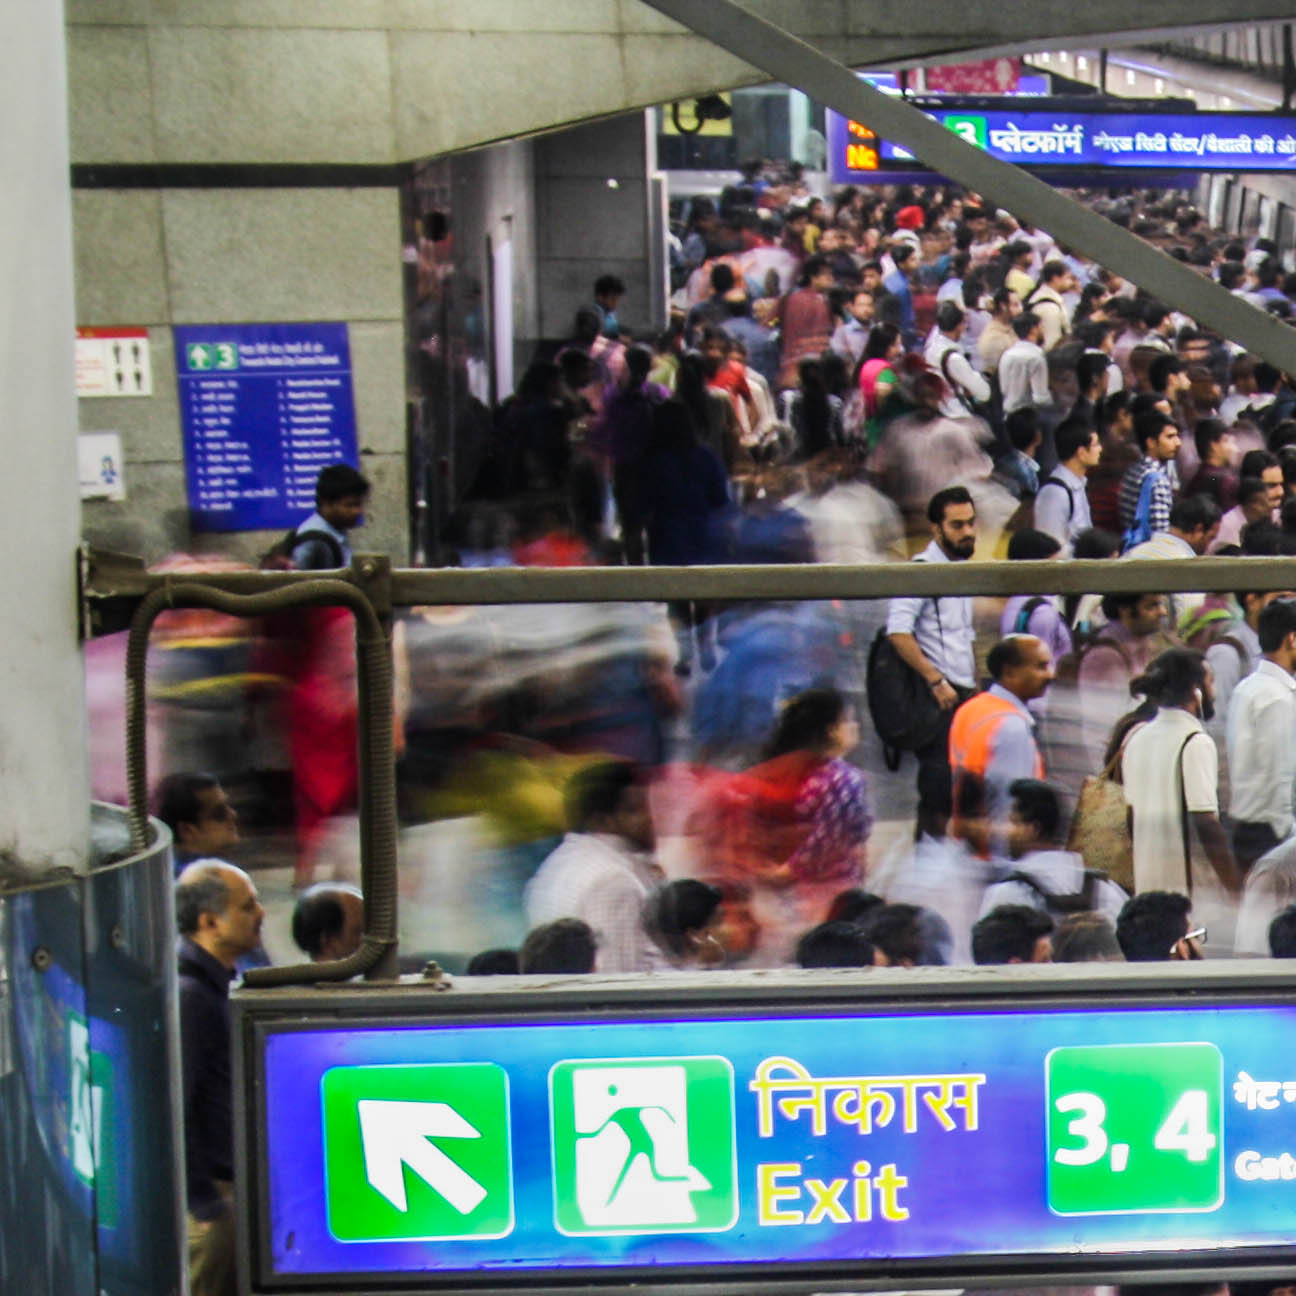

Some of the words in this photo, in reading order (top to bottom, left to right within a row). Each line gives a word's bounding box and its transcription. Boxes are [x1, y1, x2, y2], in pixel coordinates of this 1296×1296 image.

[989, 121, 1084, 154] प्लेटफॉर्म
[217, 343, 233, 368] 3
[750, 1056, 985, 1138] निकास
[1054, 1092, 1130, 1172] 3,
[1154, 1090, 1216, 1161] 4
[757, 1161, 909, 1226] Exit
